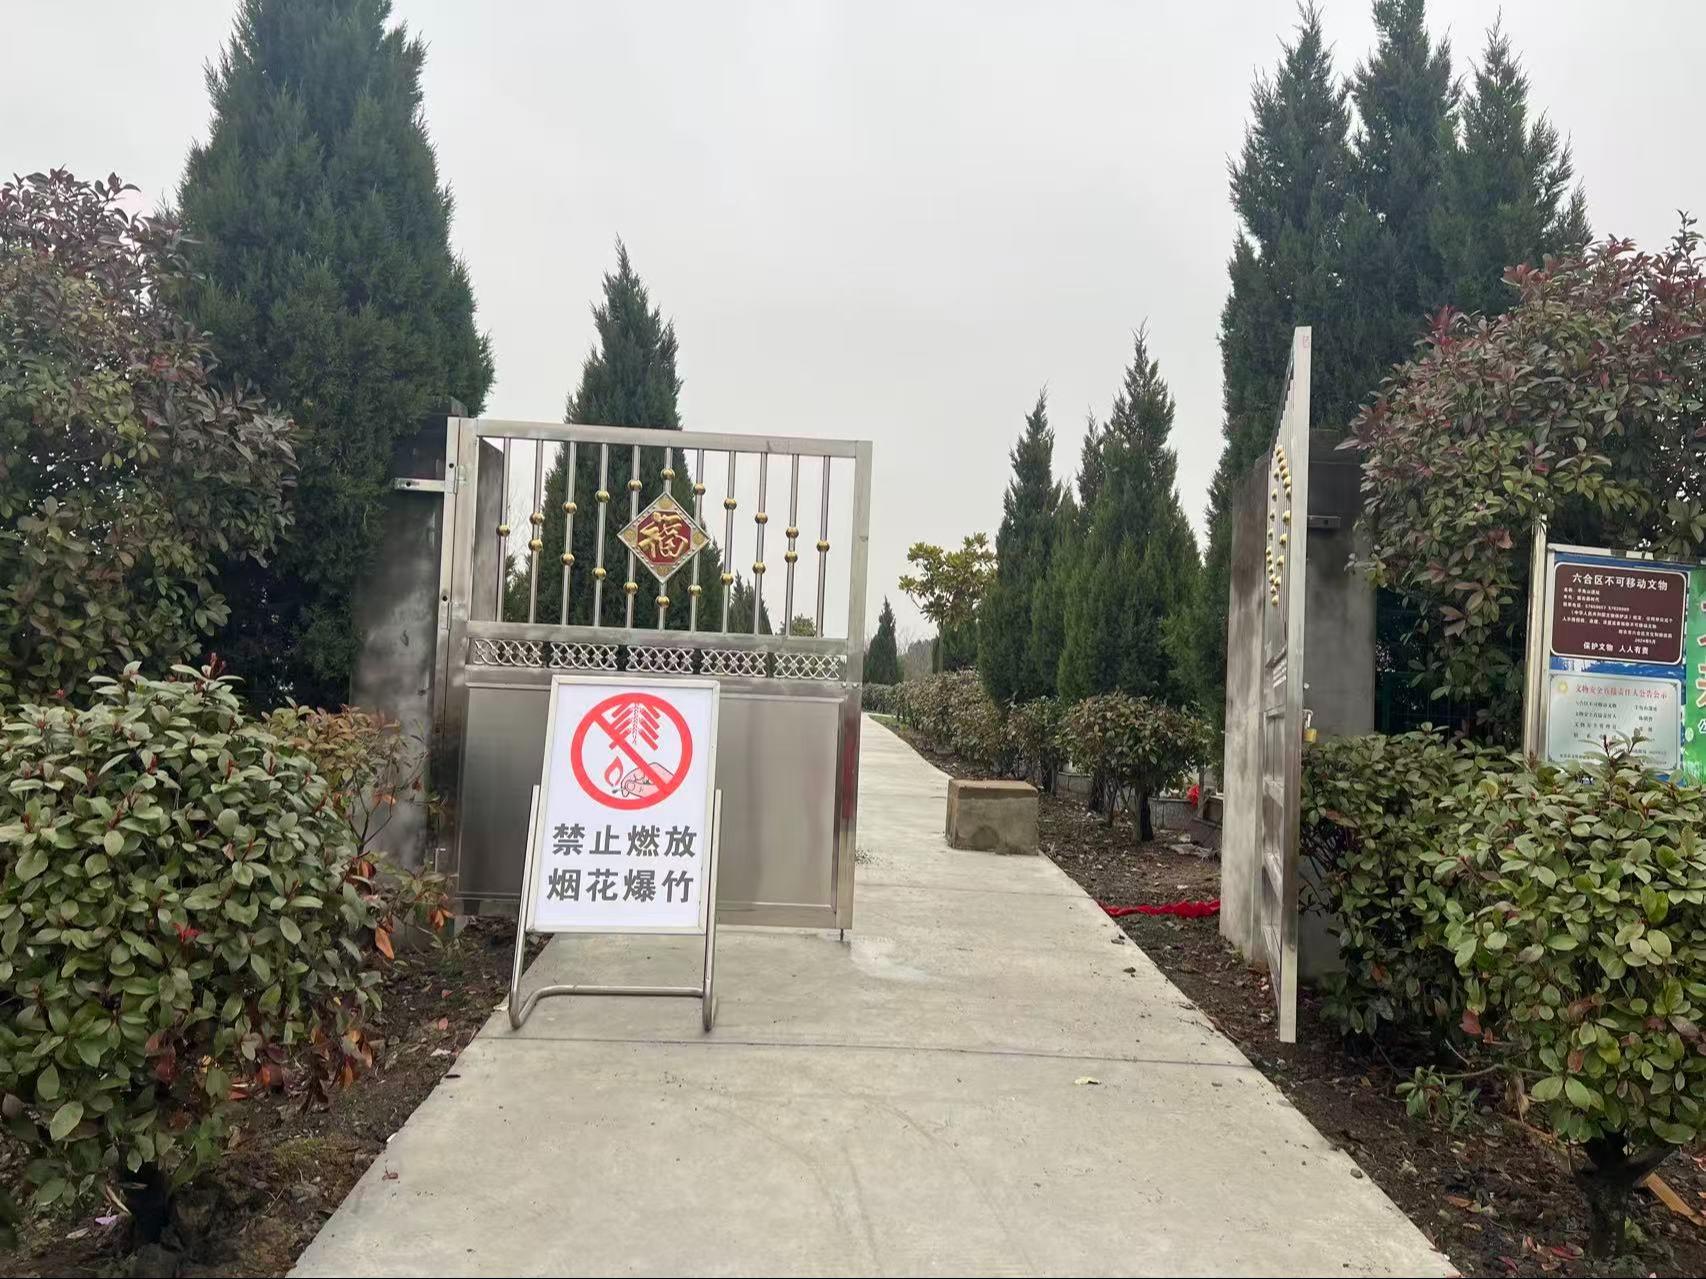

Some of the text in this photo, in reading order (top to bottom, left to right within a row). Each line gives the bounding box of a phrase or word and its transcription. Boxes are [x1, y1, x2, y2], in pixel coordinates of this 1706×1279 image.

[638, 511, 689, 558] 福
[1573, 573, 1668, 591] 六合区不可移动文物
[1583, 641, 1649, 655] 保护文物 人人有责
[552, 823, 697, 858] 禁止燃放
[547, 868, 694, 903] 烟花爆竹
